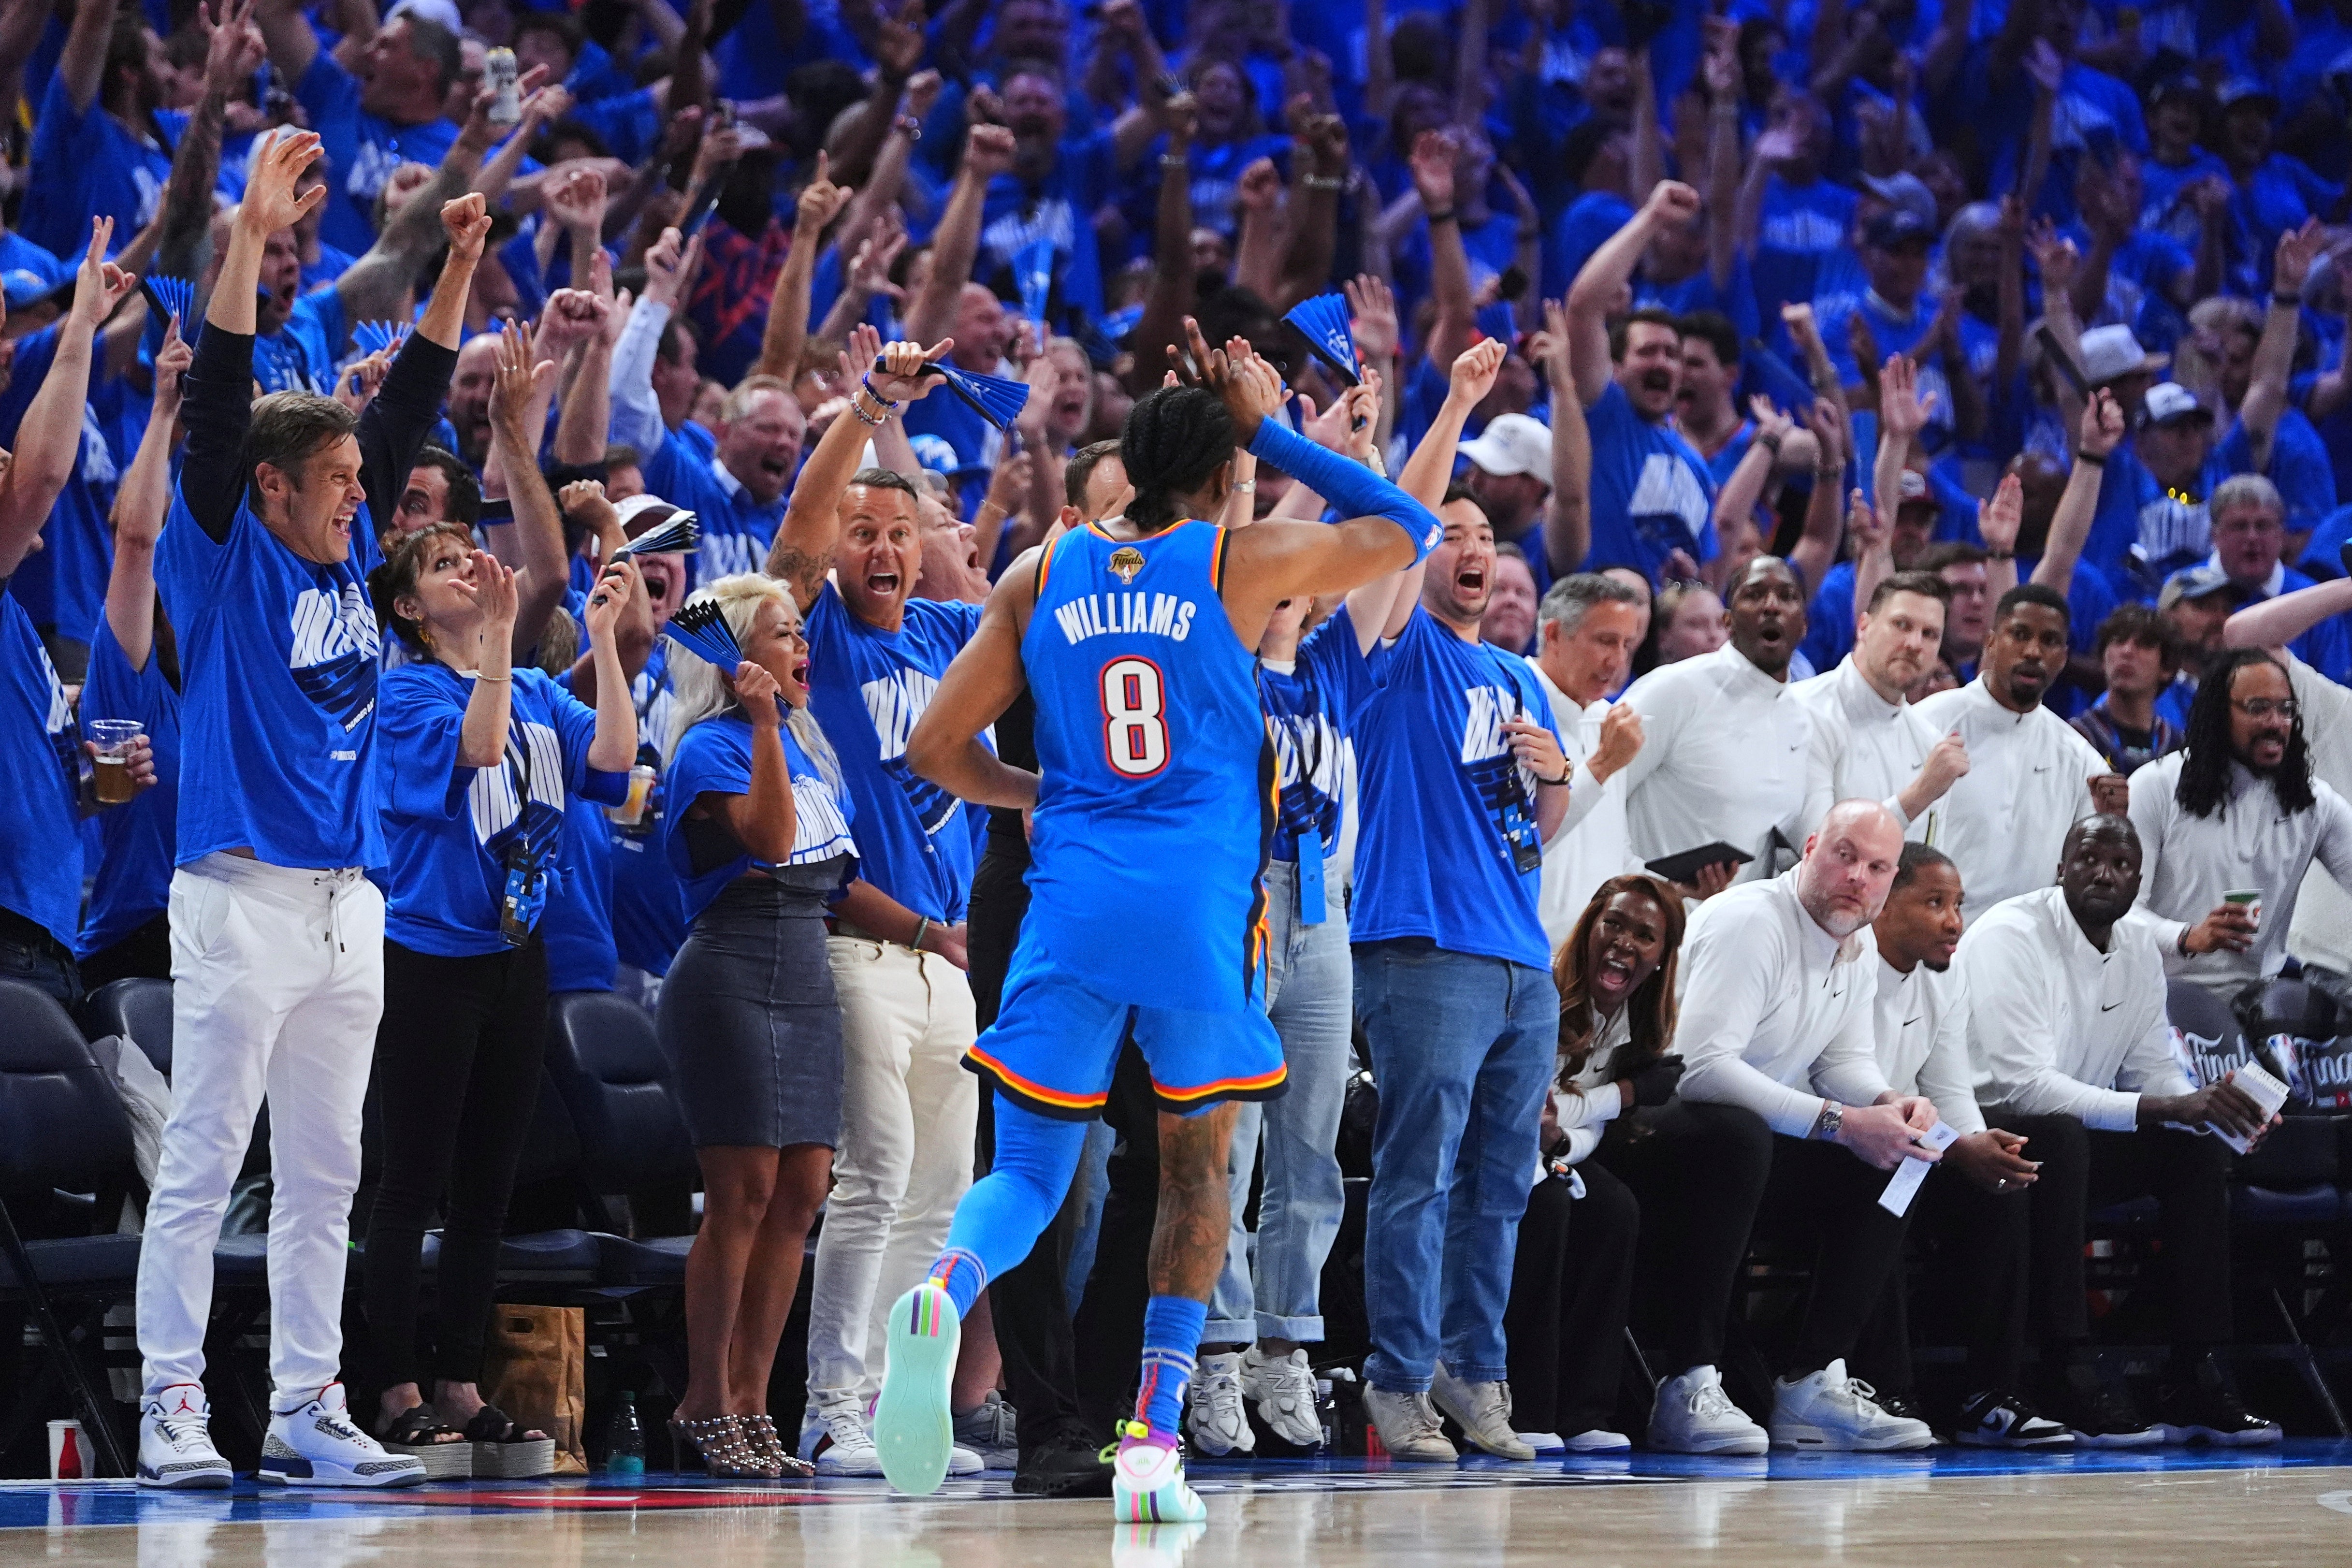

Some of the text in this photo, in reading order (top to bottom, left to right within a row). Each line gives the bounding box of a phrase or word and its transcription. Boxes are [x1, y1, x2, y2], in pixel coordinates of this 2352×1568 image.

[1110, 553, 1144, 570] Finals
[1055, 592, 1196, 645] WILLIAMS
[1100, 656, 1170, 778] 8
